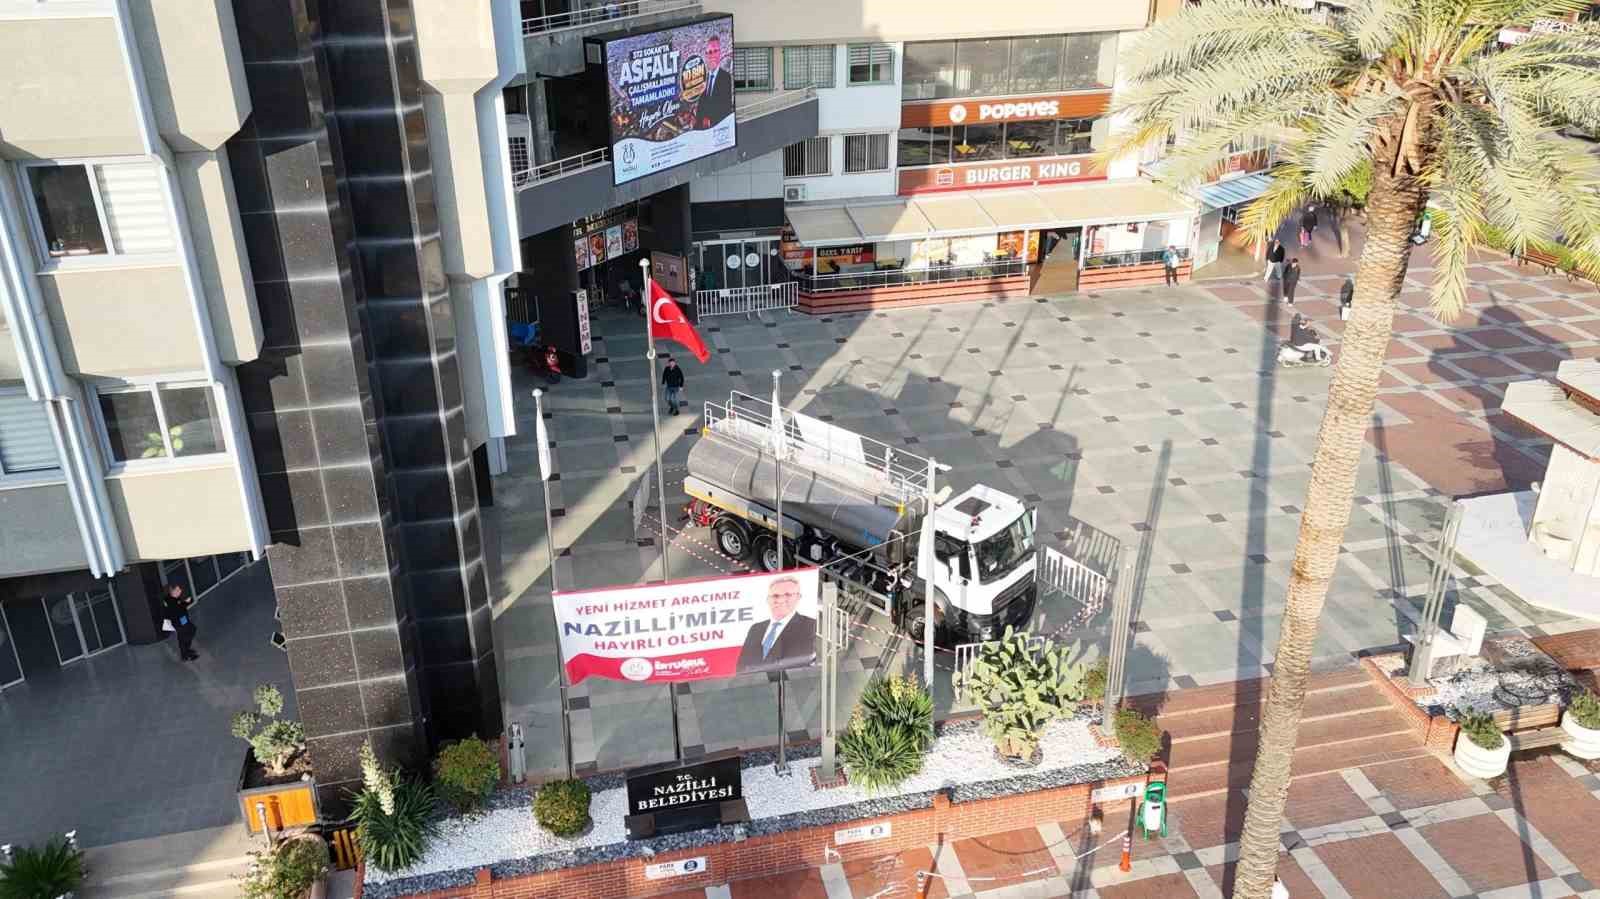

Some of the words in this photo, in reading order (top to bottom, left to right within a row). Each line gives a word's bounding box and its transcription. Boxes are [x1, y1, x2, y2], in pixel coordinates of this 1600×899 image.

[619, 50, 680, 86] ASFALT
[979, 101, 1059, 120] POPEYES
[966, 165, 1031, 184] BURGER
[1039, 162, 1081, 178] KING
[613, 598, 667, 612] HİZMET
[671, 590, 741, 606] ARACIMIZ
[564, 606, 754, 637] NAZİLLİ'MİZE
[594, 637, 662, 650] HAYIRLI
[667, 629, 725, 646] OLSUN
[653, 776, 717, 796] NAZİLLİ
[637, 785, 733, 811] BELEDİYESİ
